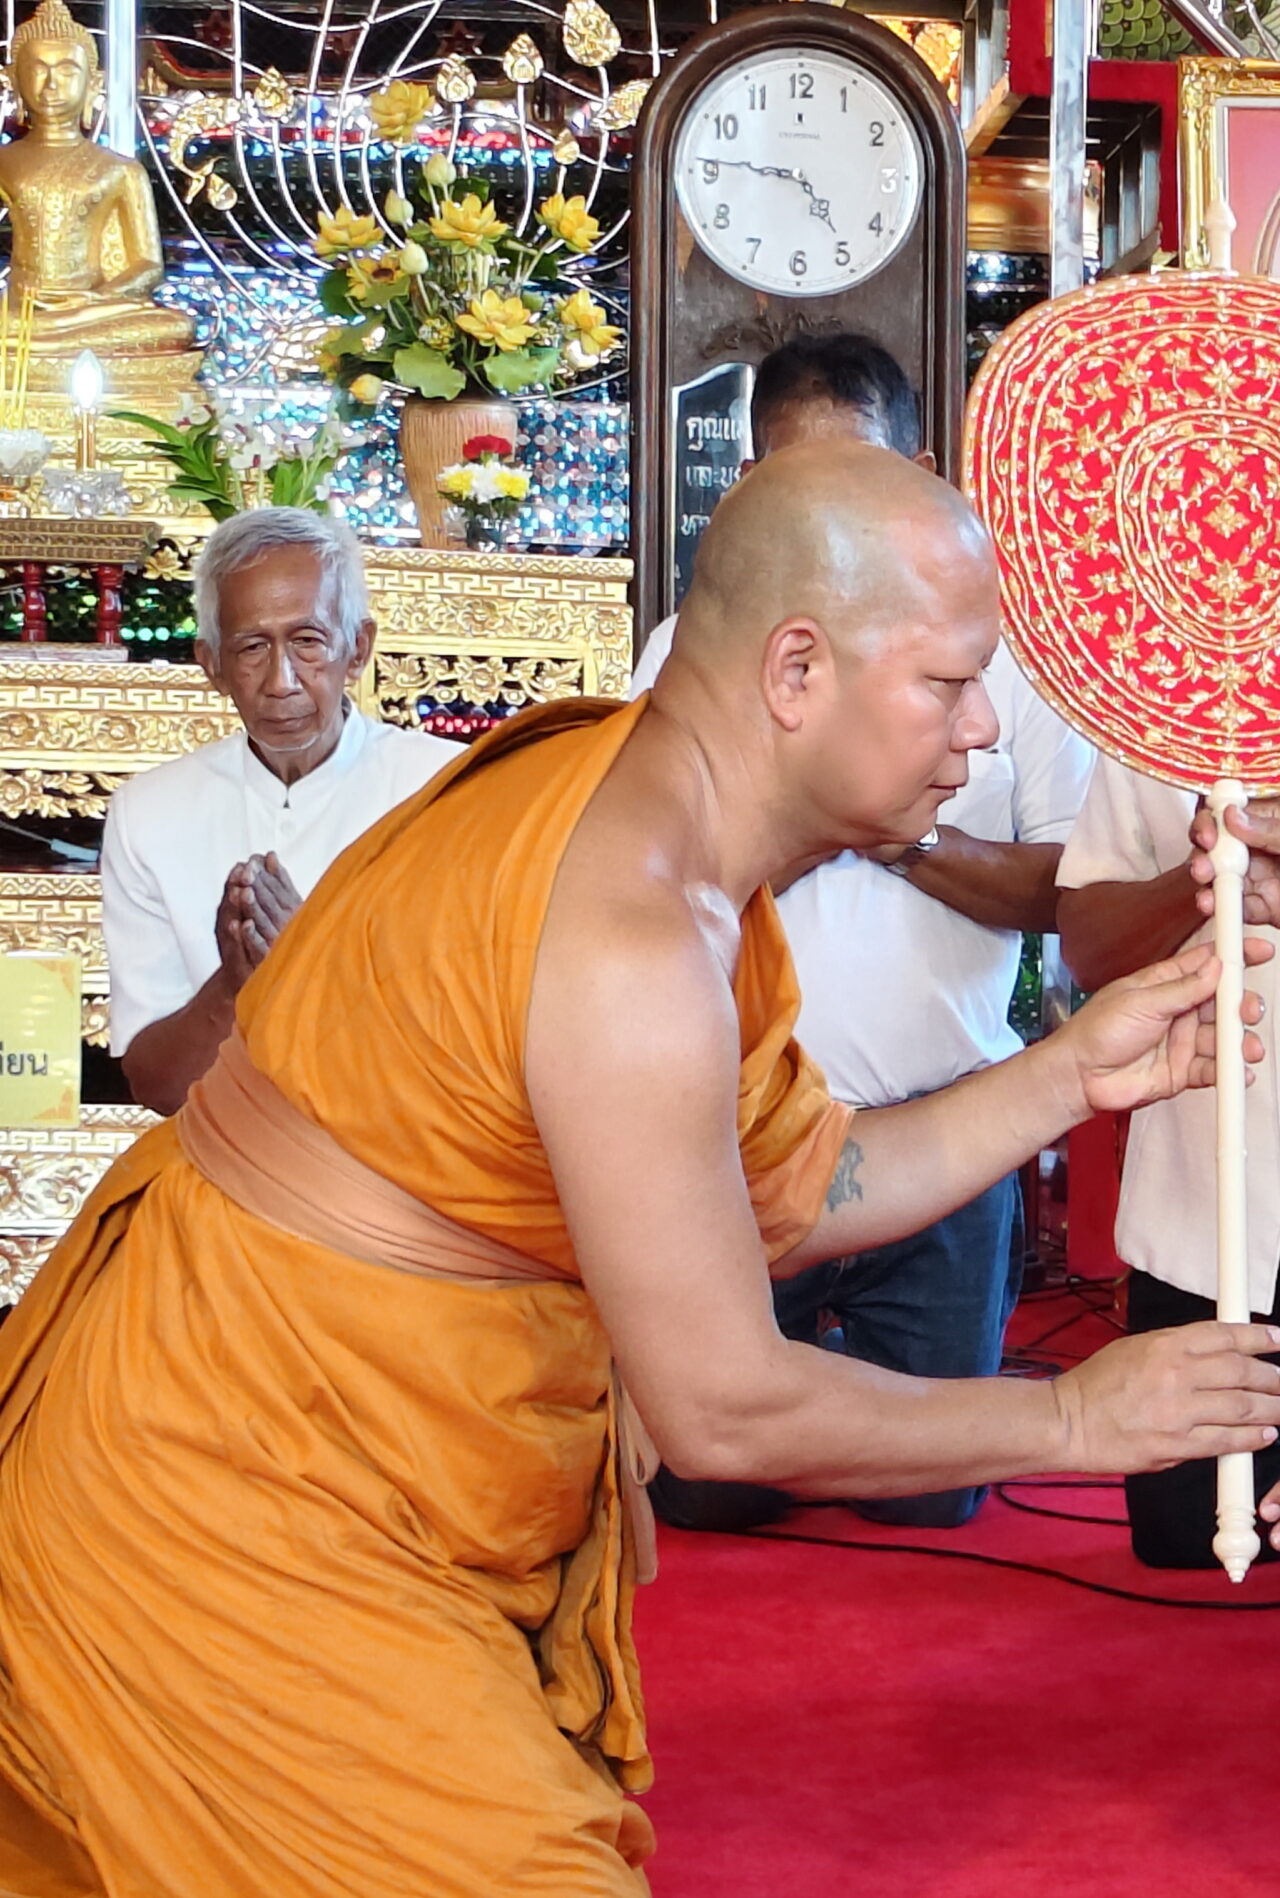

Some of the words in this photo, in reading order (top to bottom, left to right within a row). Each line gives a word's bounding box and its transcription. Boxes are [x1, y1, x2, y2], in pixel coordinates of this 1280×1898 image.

[748, 84, 767, 111] 11
[789, 73, 814, 99] 12
[840, 86, 848, 113] 1
[714, 113, 739, 140] 10
[869, 121, 884, 147] 2
[702, 160, 719, 184] 9
[881, 168, 899, 194] 3
[713, 203, 730, 229] 8
[868, 211, 883, 238] 4
[745, 237, 762, 264] 7
[789, 250, 807, 276] 6
[835, 241, 851, 267] 5
